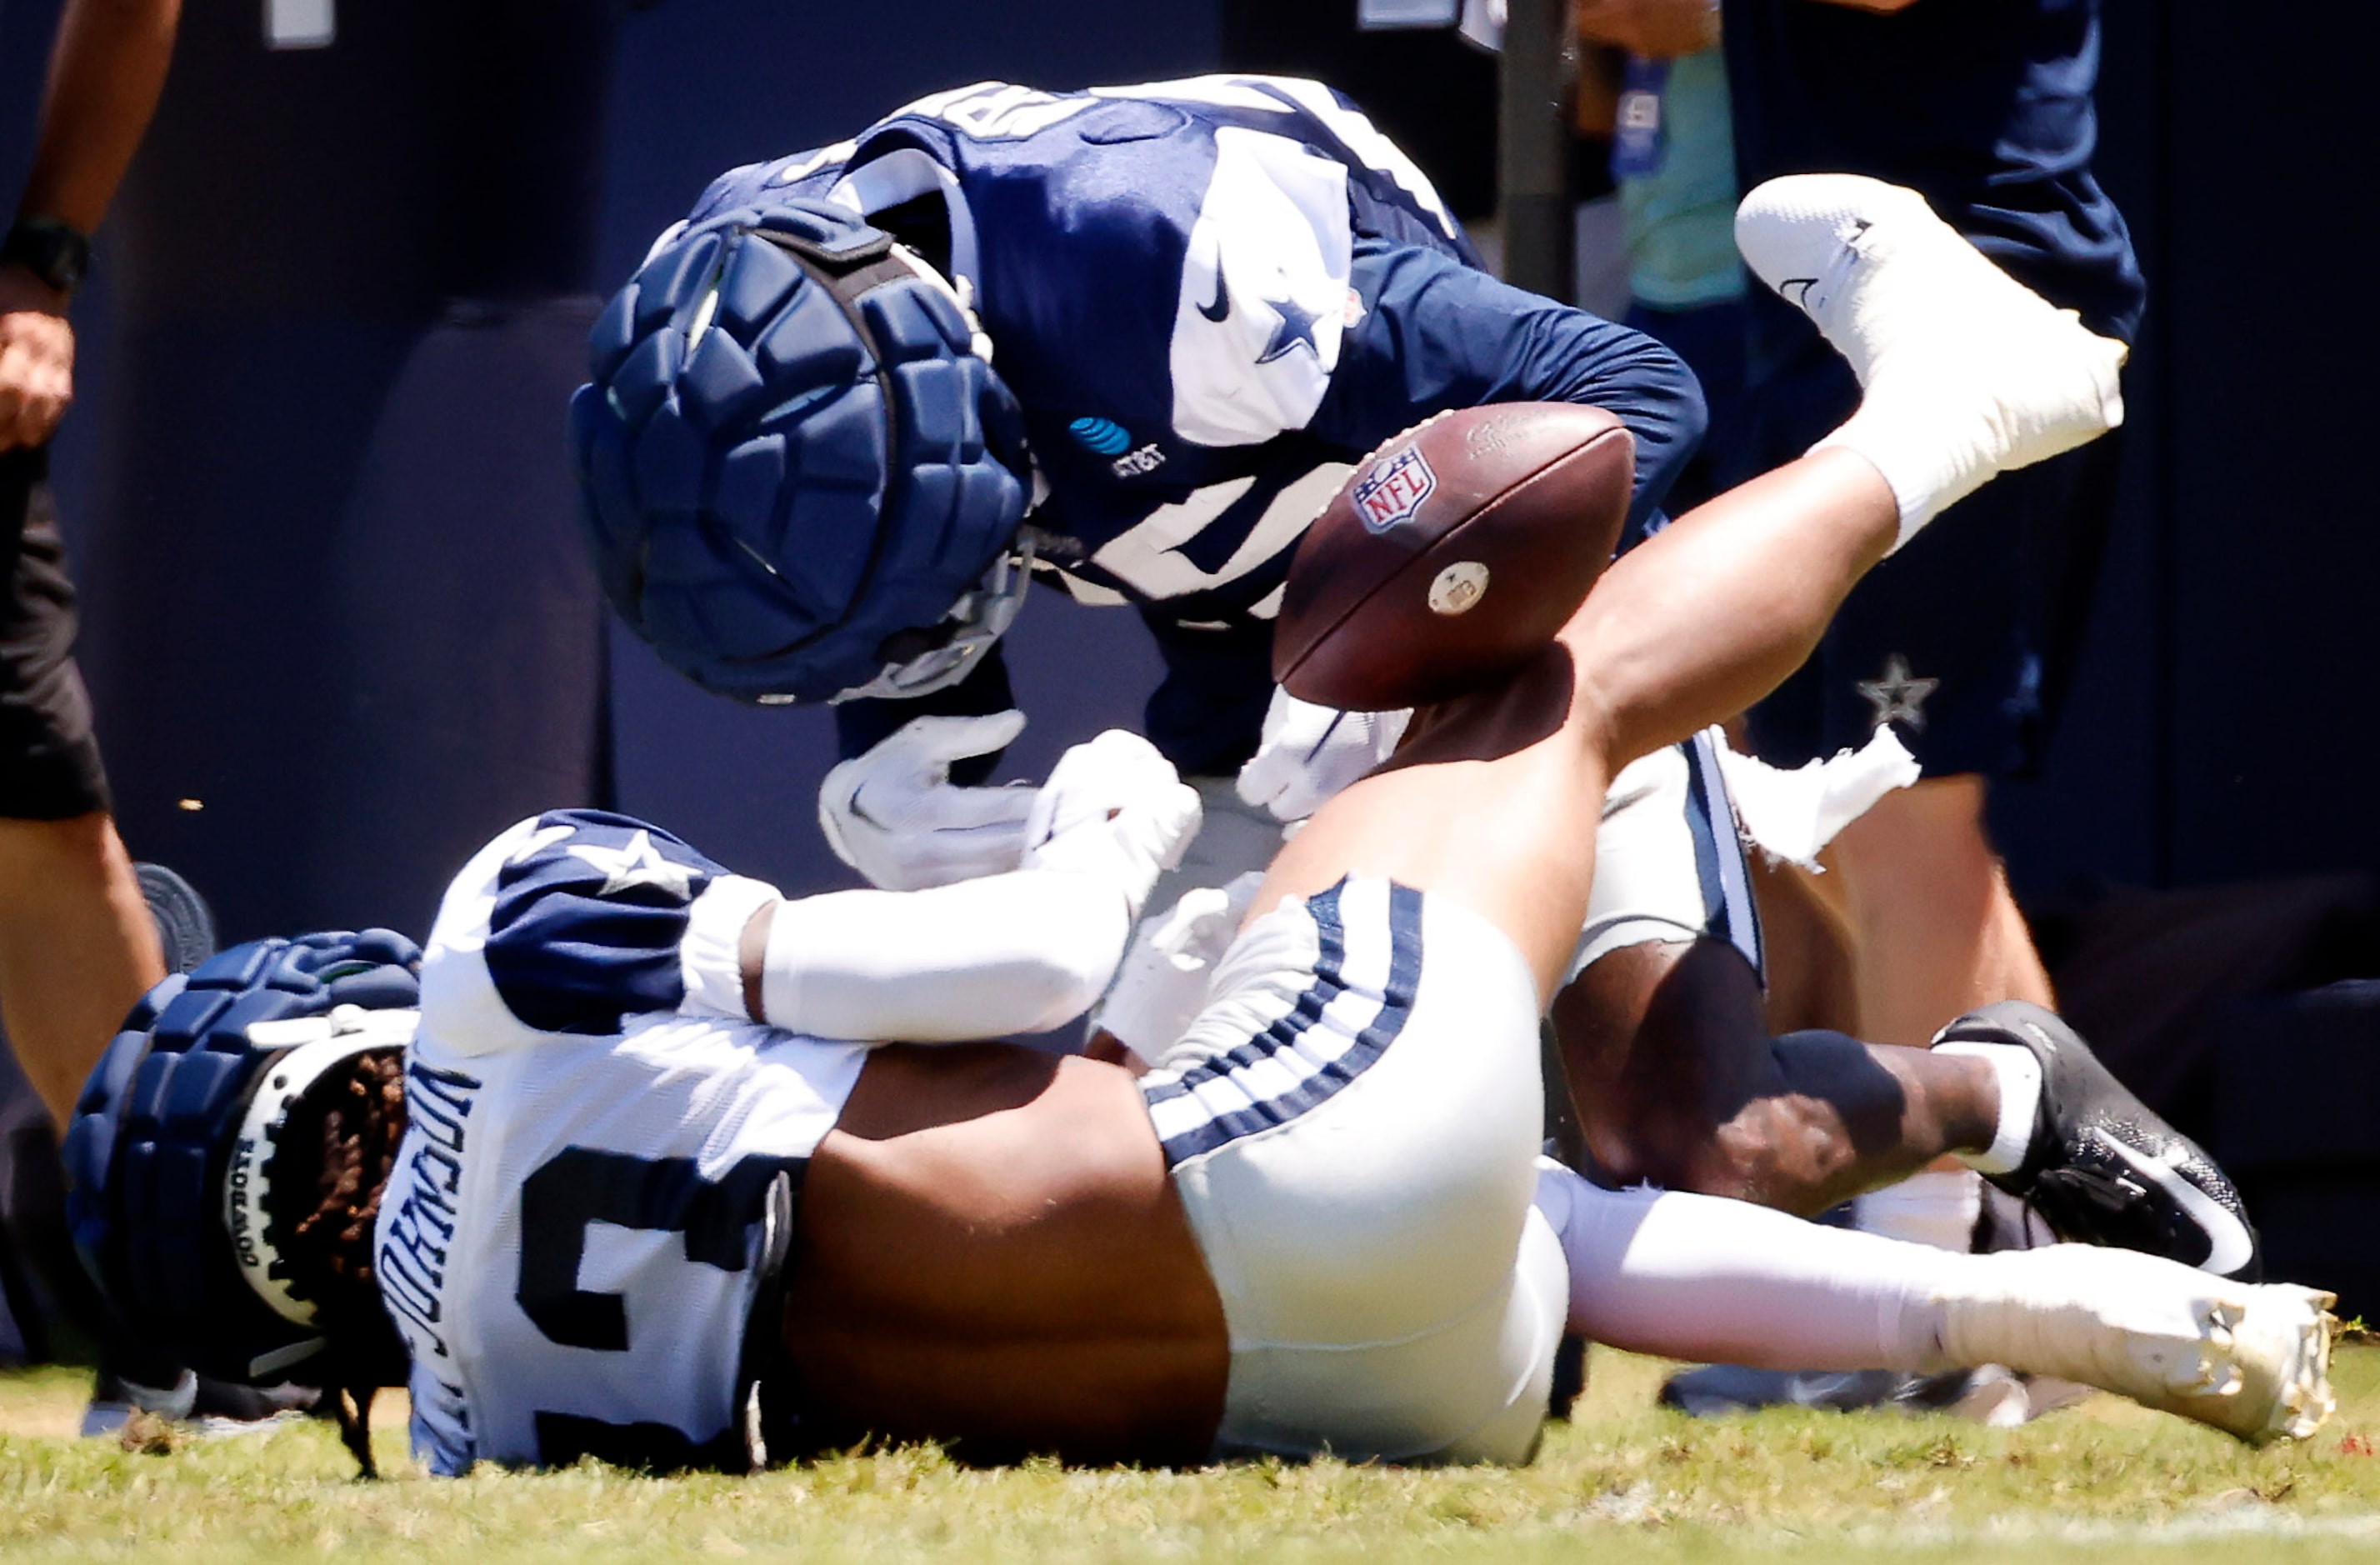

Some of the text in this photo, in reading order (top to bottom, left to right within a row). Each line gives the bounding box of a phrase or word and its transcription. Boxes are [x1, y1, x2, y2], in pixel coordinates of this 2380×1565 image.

[1112, 442, 1167, 478] AT&T
[1365, 468, 1426, 523] NFL
[380, 1060, 482, 1358] JOHNSON
